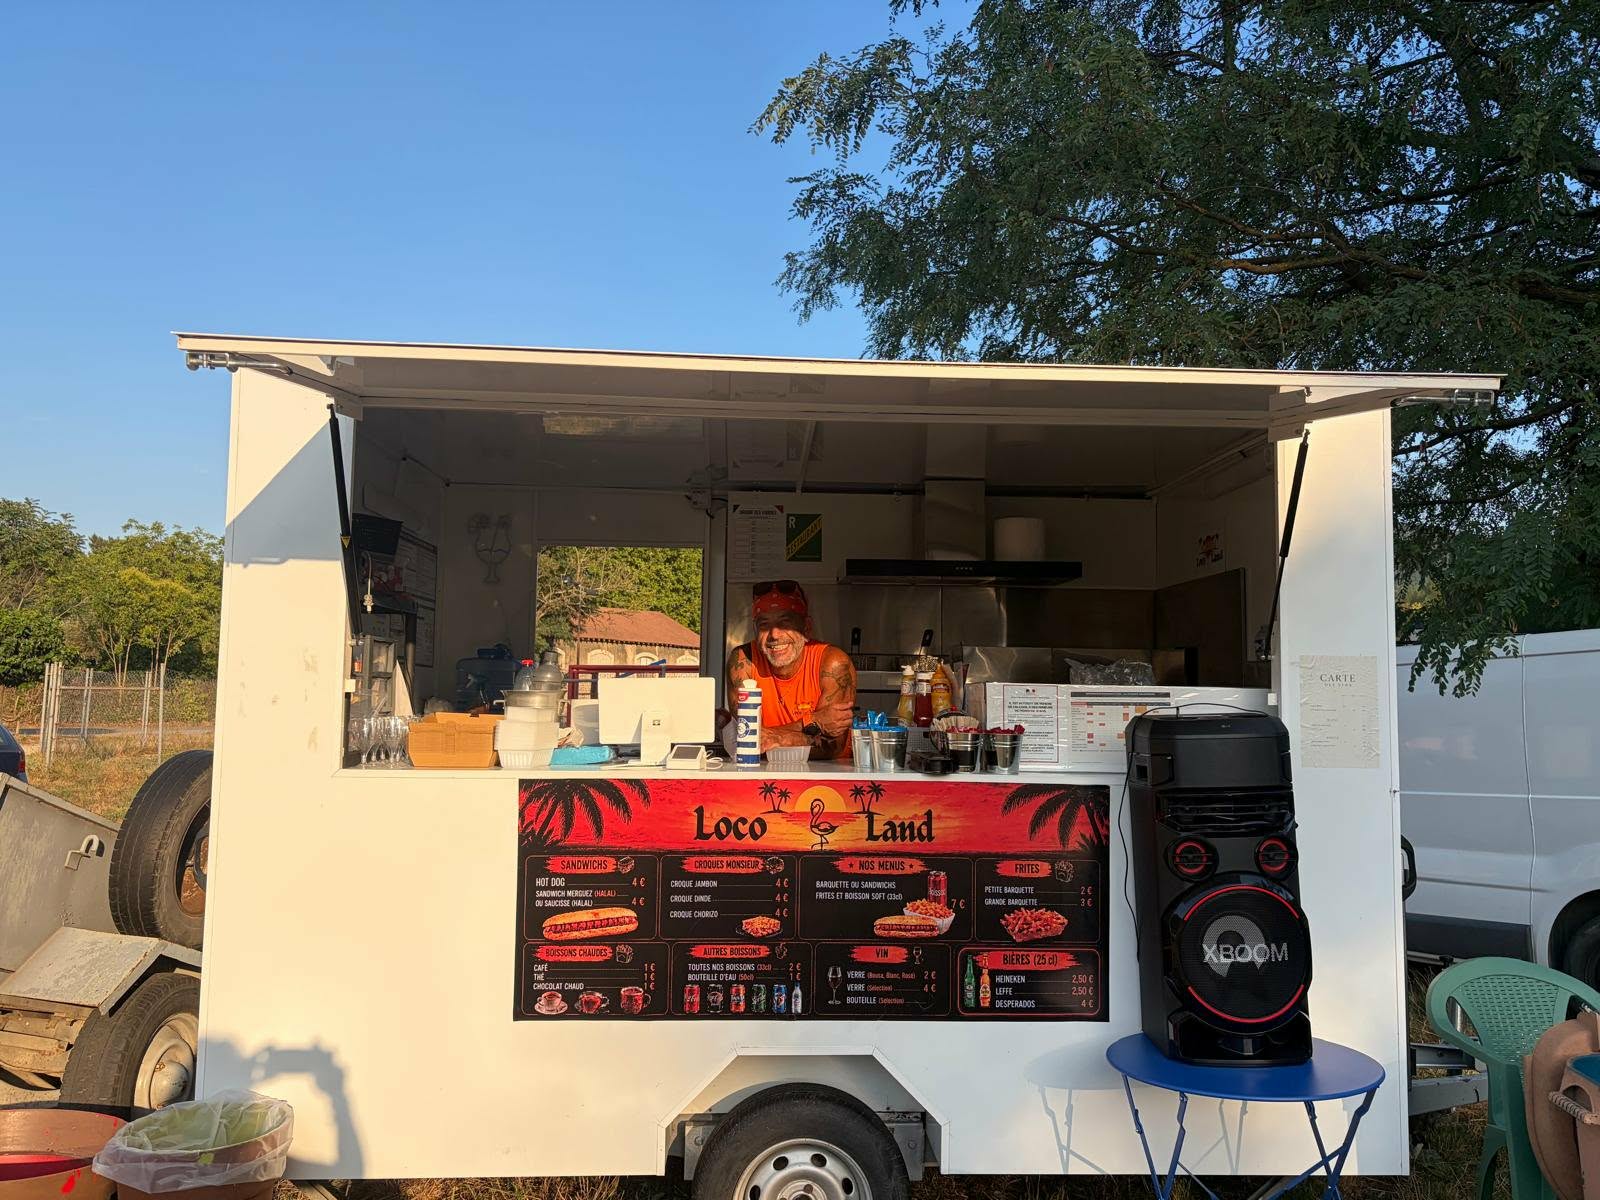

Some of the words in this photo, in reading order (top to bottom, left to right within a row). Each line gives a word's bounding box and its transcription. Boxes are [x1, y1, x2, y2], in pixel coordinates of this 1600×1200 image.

[788, 516, 795, 528] R
[1320, 674, 1356, 682] CARTE
[694, 805, 767, 841] Loco
[865, 809, 935, 842] Land
[560, 860, 608, 870] SANDWICHS
[694, 860, 724, 869] CROQUES
[726, 860, 759, 869] MONSIEUR
[859, 860, 874, 870] NOS
[878, 860, 905, 871] MENUS
[1015, 864, 1040, 874] FRITES
[536, 878, 548, 887] HOT
[551, 878, 565, 887] DOG
[632, 877, 637, 887] 4
[670, 880, 693, 888] CROQUE
[694, 880, 717, 888] JAMBON
[775, 878, 780, 887] 4
[816, 881, 849, 889] BARQUETTE
[851, 881, 859, 889] OU
[861, 881, 896, 889] SANDWICHS
[536, 890, 565, 898] SANDWICH
[567, 890, 592, 898] MERGUEZ
[1004, 886, 1034, 894] BARQUETTE
[632, 897, 637, 906] 4
[775, 893, 780, 902] 4
[952, 899, 957, 908] 7
[775, 908, 780, 917] 4
[546, 949, 577, 957] BOISSONS
[578, 949, 608, 957] CHAUDES
[703, 948, 728, 956] AUTRES
[730, 948, 761, 956] BOISSONS
[876, 949, 888, 958] VIN
[1202, 942, 1288, 963] XBOOM
[1003, 952, 1030, 965] BIÈRES
[1034, 955, 1047, 965] (25
[1049, 955, 1058, 966] cl)
[534, 963, 548, 972] CAFÉ
[789, 963, 793, 971] 2
[534, 972, 545, 980] THÉ
[924, 971, 928, 979] 2
[996, 975, 1025, 983] HEINEKEN
[1088, 975, 1094, 983] €
[533, 982, 563, 990] CHOCOLAT
[564, 982, 584, 990] CHAUD
[924, 984, 928, 992] 4
[1088, 987, 1094, 996] €
[995, 1000, 1035, 1008] DESPERADOS
